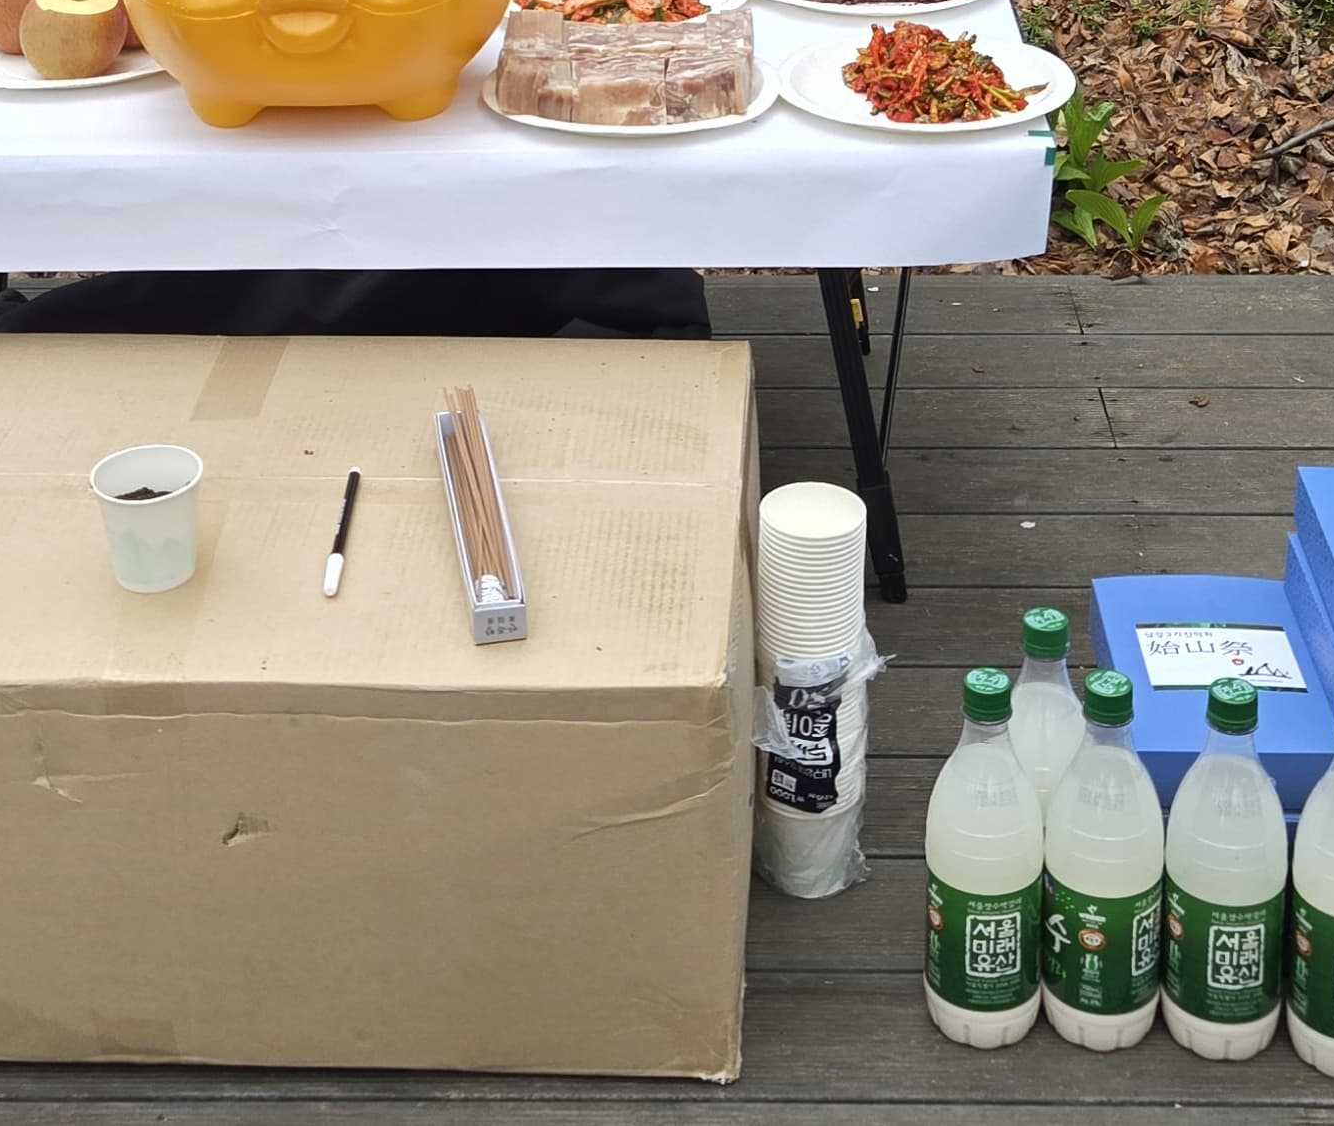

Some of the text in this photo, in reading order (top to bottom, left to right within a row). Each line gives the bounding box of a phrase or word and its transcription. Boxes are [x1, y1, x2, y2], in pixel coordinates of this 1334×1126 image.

[1147, 640, 1254, 657] 始山祭
[972, 919, 1016, 939] 서울
[972, 937, 1016, 954] 미래
[1215, 931, 1259, 951] 서울
[971, 953, 1016, 972] 유산
[1215, 948, 1259, 965] 미래
[1214, 965, 1259, 984] 유산
